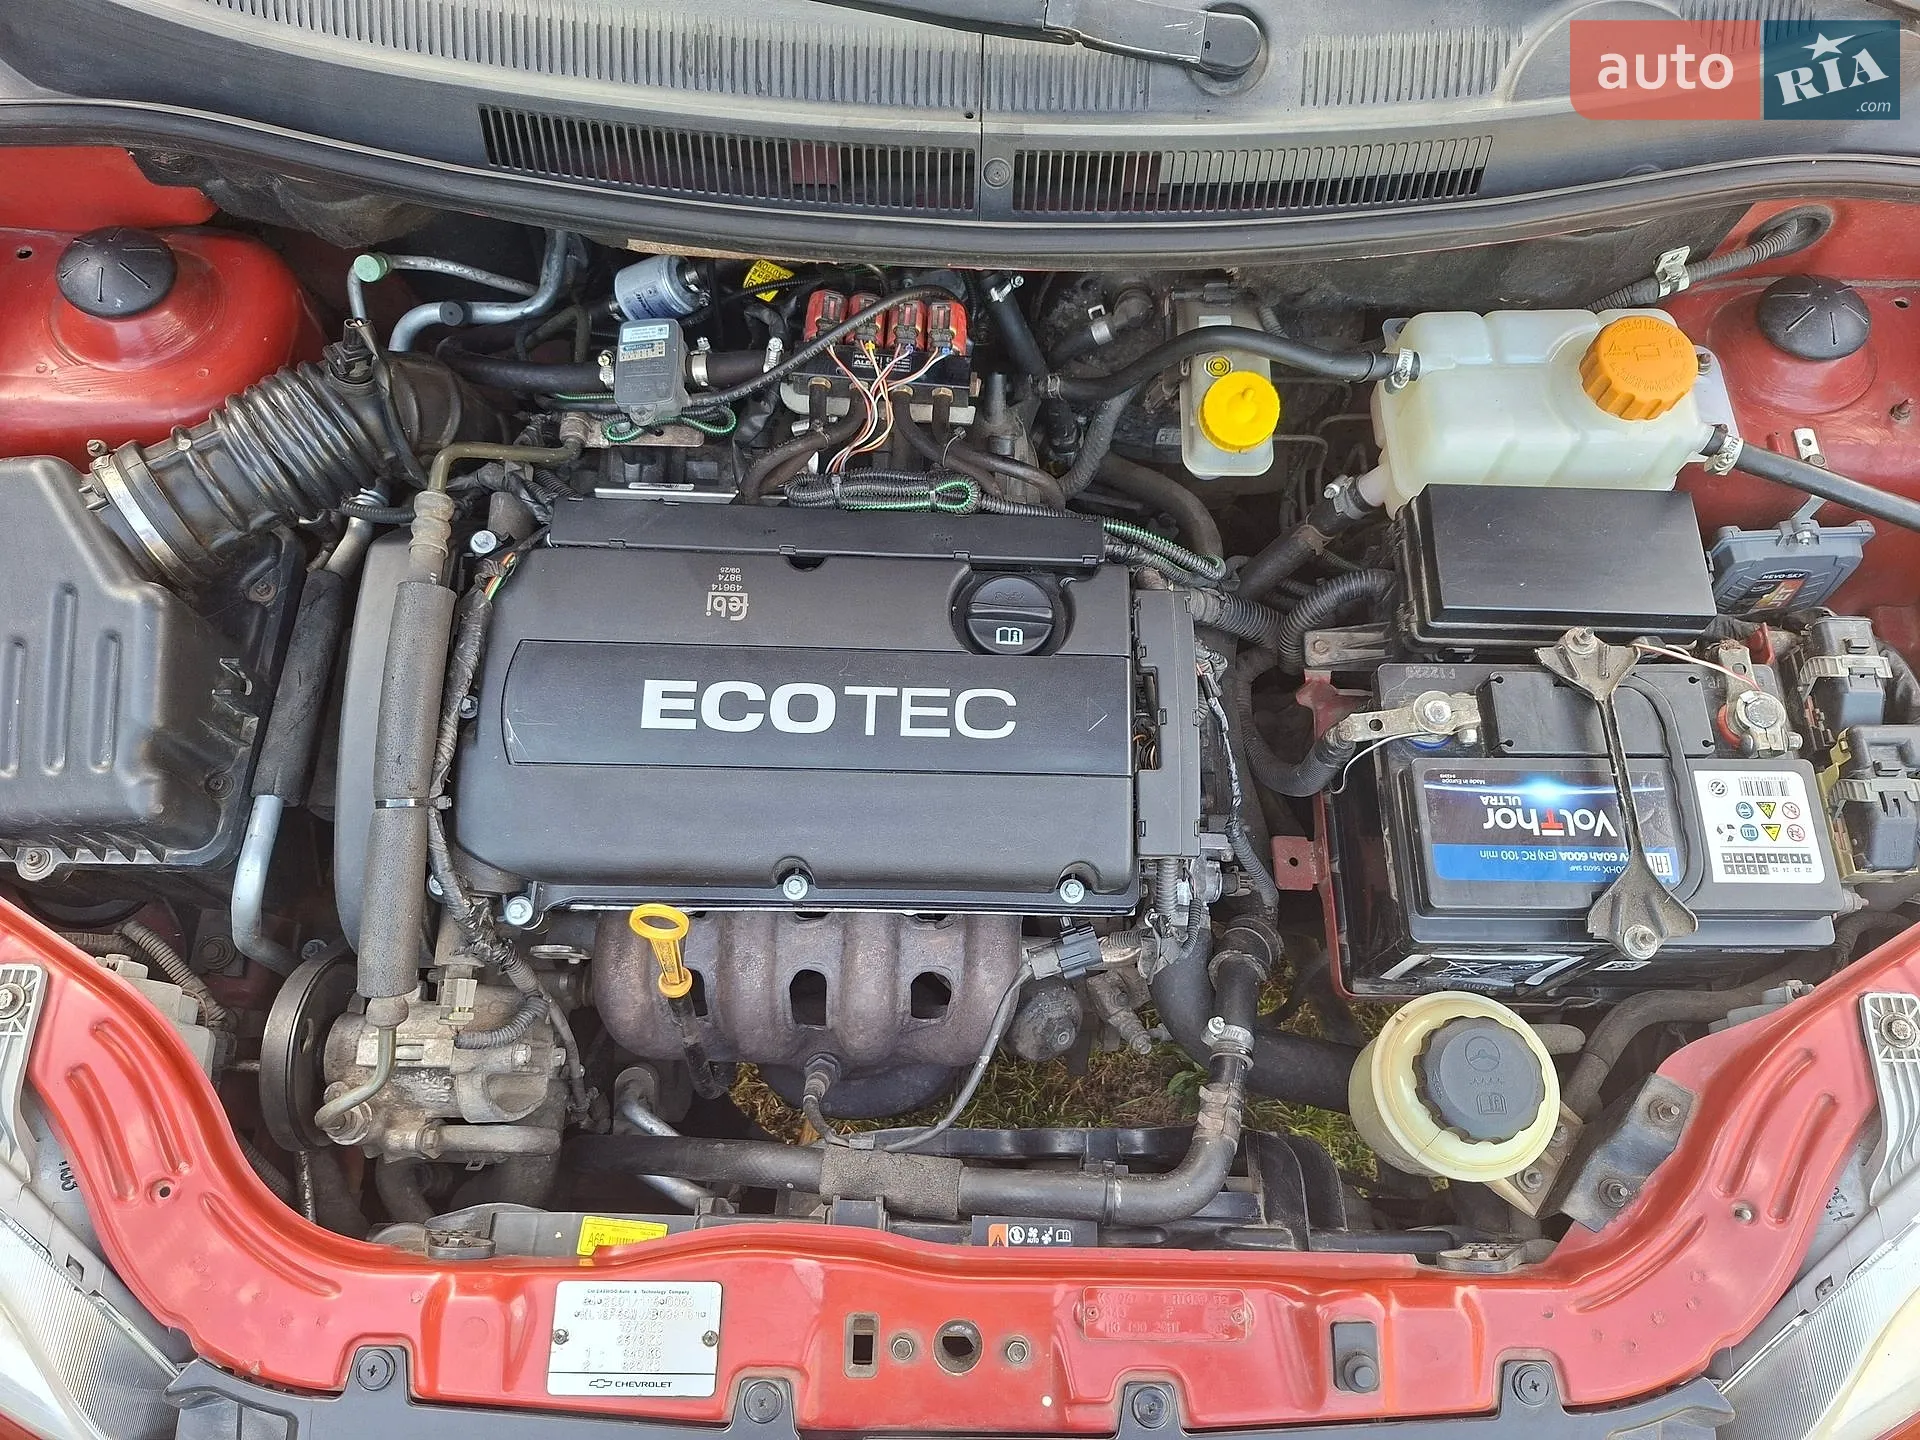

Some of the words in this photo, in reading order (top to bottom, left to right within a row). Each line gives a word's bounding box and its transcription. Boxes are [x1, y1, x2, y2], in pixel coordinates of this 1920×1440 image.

[718, 574, 742, 582] 9874
[711, 583, 743, 592] 49614
[705, 592, 750, 621] febi
[641, 679, 1018, 739] ECOTEC
[1480, 795, 1522, 807] ULTRA
[1482, 807, 1618, 838] VolThor
[1479, 850, 1498, 860] min
[1500, 850, 1520, 860] 100
[1521, 851, 1537, 860] RC
[1537, 849, 1558, 861] (EN)
[1559, 851, 1588, 861] 600A
[1589, 851, 1618, 861] 60Ah
